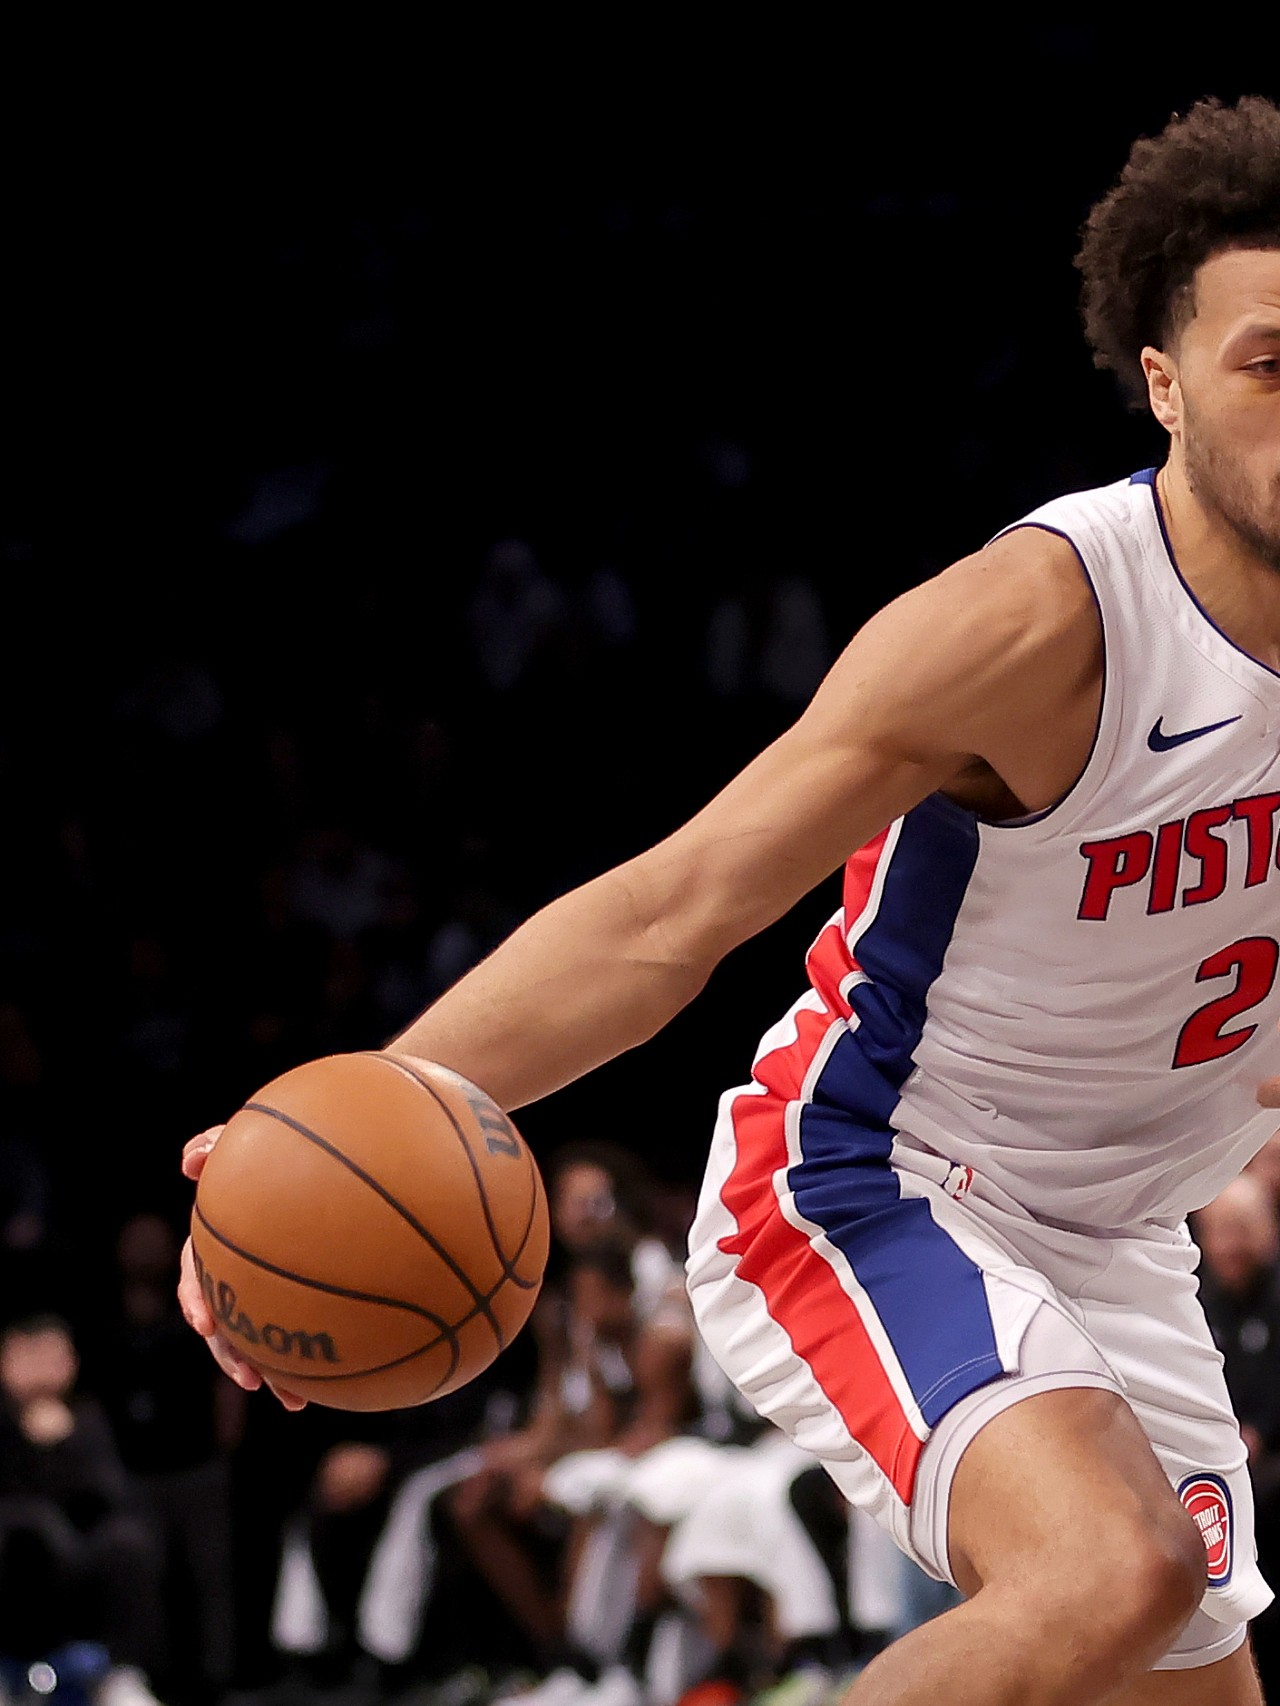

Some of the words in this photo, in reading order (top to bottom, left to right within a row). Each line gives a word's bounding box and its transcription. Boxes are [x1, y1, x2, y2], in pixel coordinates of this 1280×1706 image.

[1171, 936, 1280, 1070] 2
[195, 1252, 341, 1363] ilson
[1192, 1503, 1220, 1532] TROIT
